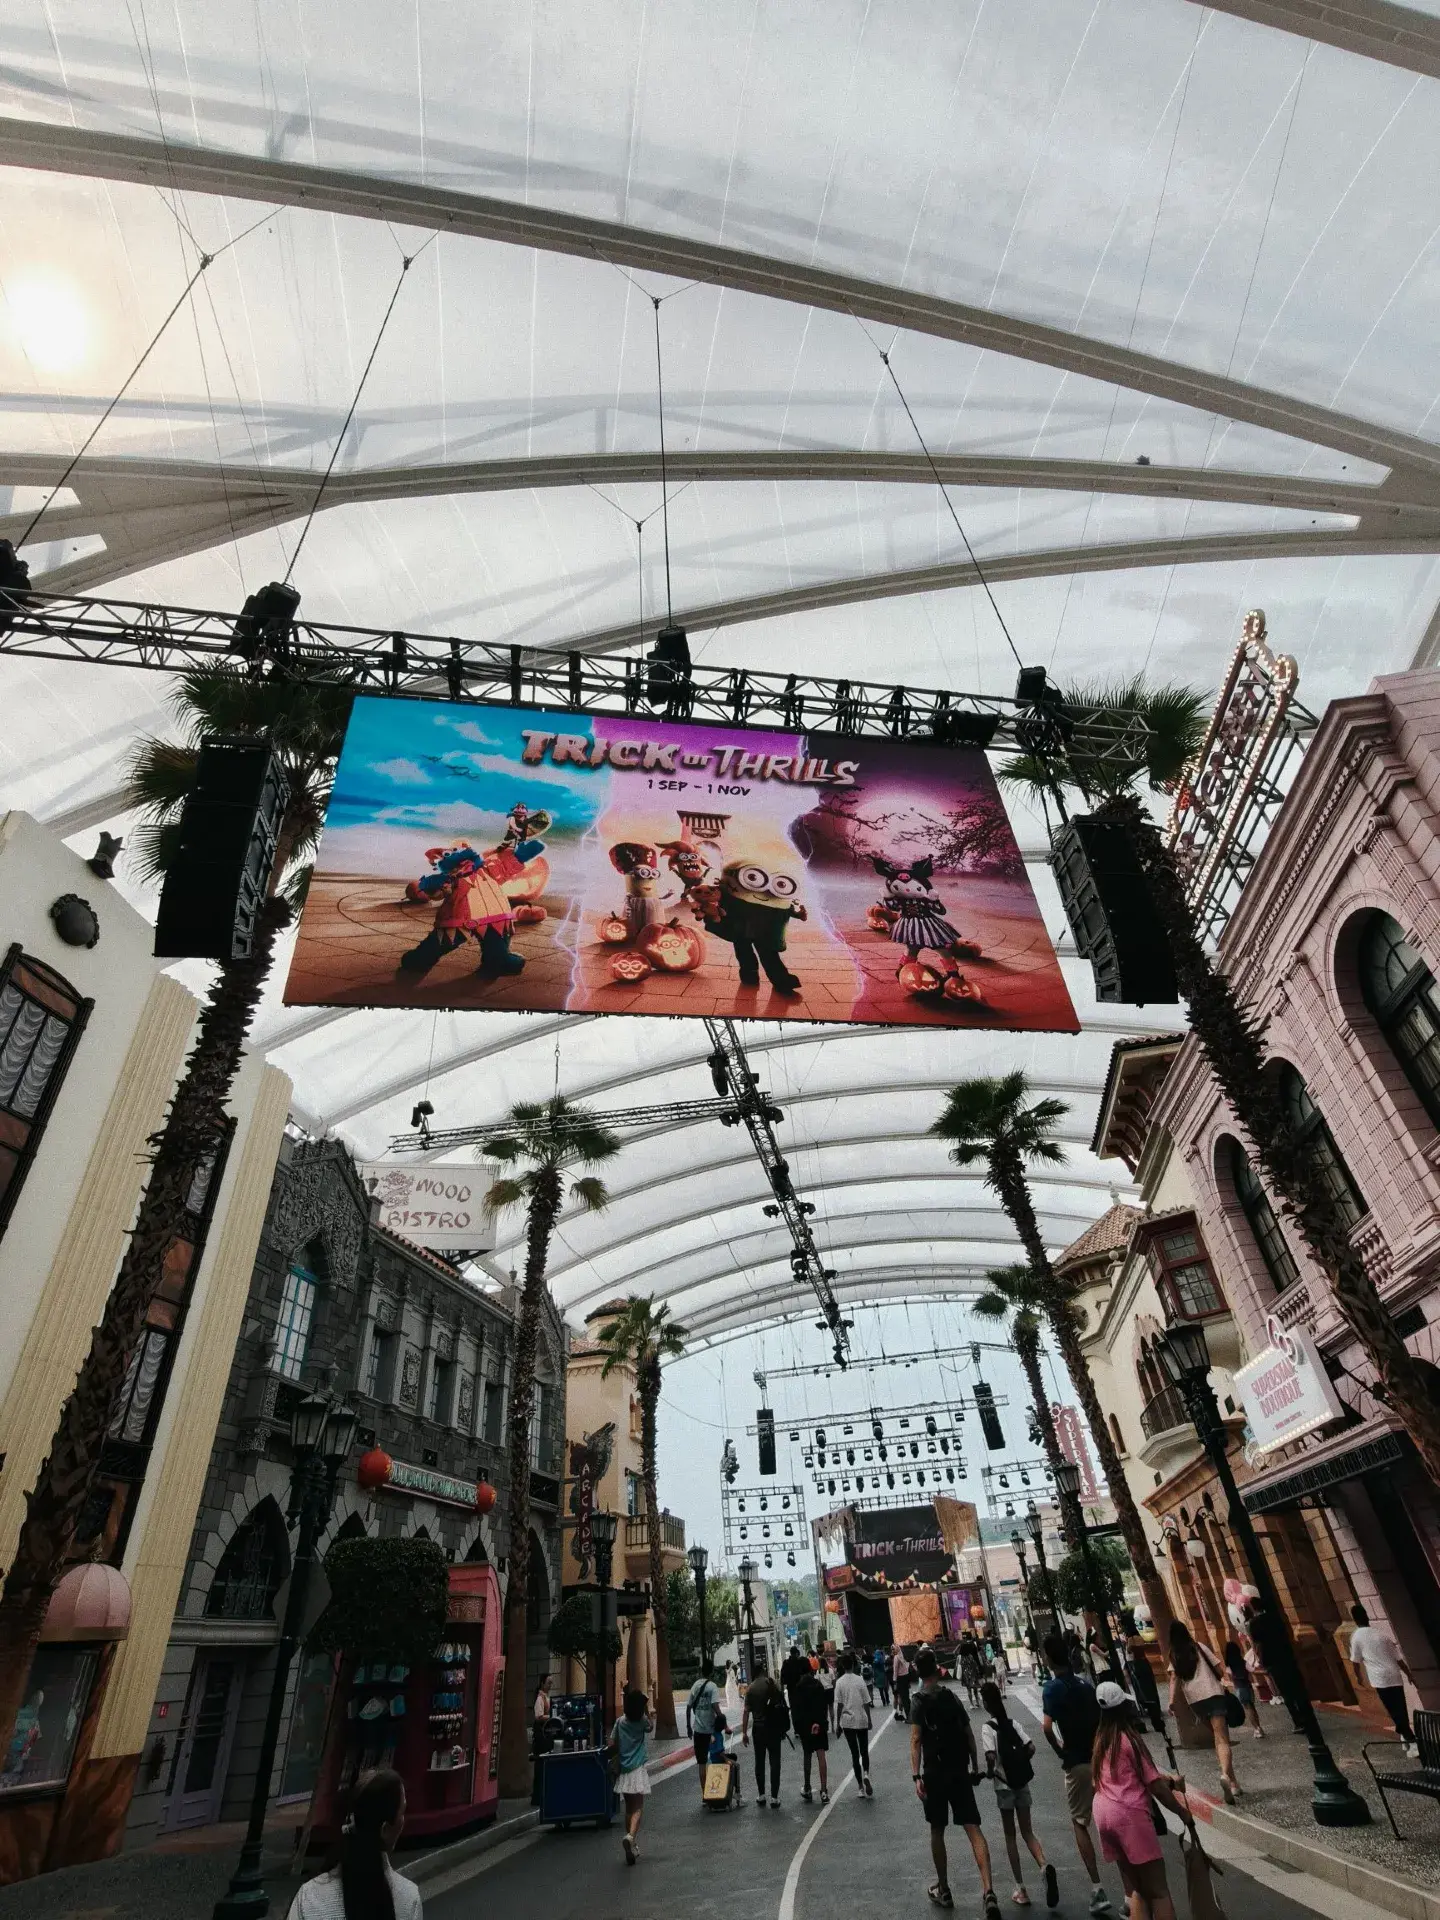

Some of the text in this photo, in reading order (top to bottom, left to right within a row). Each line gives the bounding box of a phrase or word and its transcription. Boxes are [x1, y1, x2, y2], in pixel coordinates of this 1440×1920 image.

[520, 729, 680, 773] TRICK
[710, 743, 861, 787] THRILLS
[648, 779, 654, 790] 1
[658, 779, 688, 792] SEP
[707, 784, 713, 794] 1
[717, 785, 752, 797] NOV
[387, 1209, 471, 1229] BISTRO
[1063, 1413, 1092, 1496] SUPERSTAR
[581, 1462, 591, 1554] ARCADE
[853, 1540, 895, 1560] TRICK
[902, 1537, 945, 1553] THRILLS
